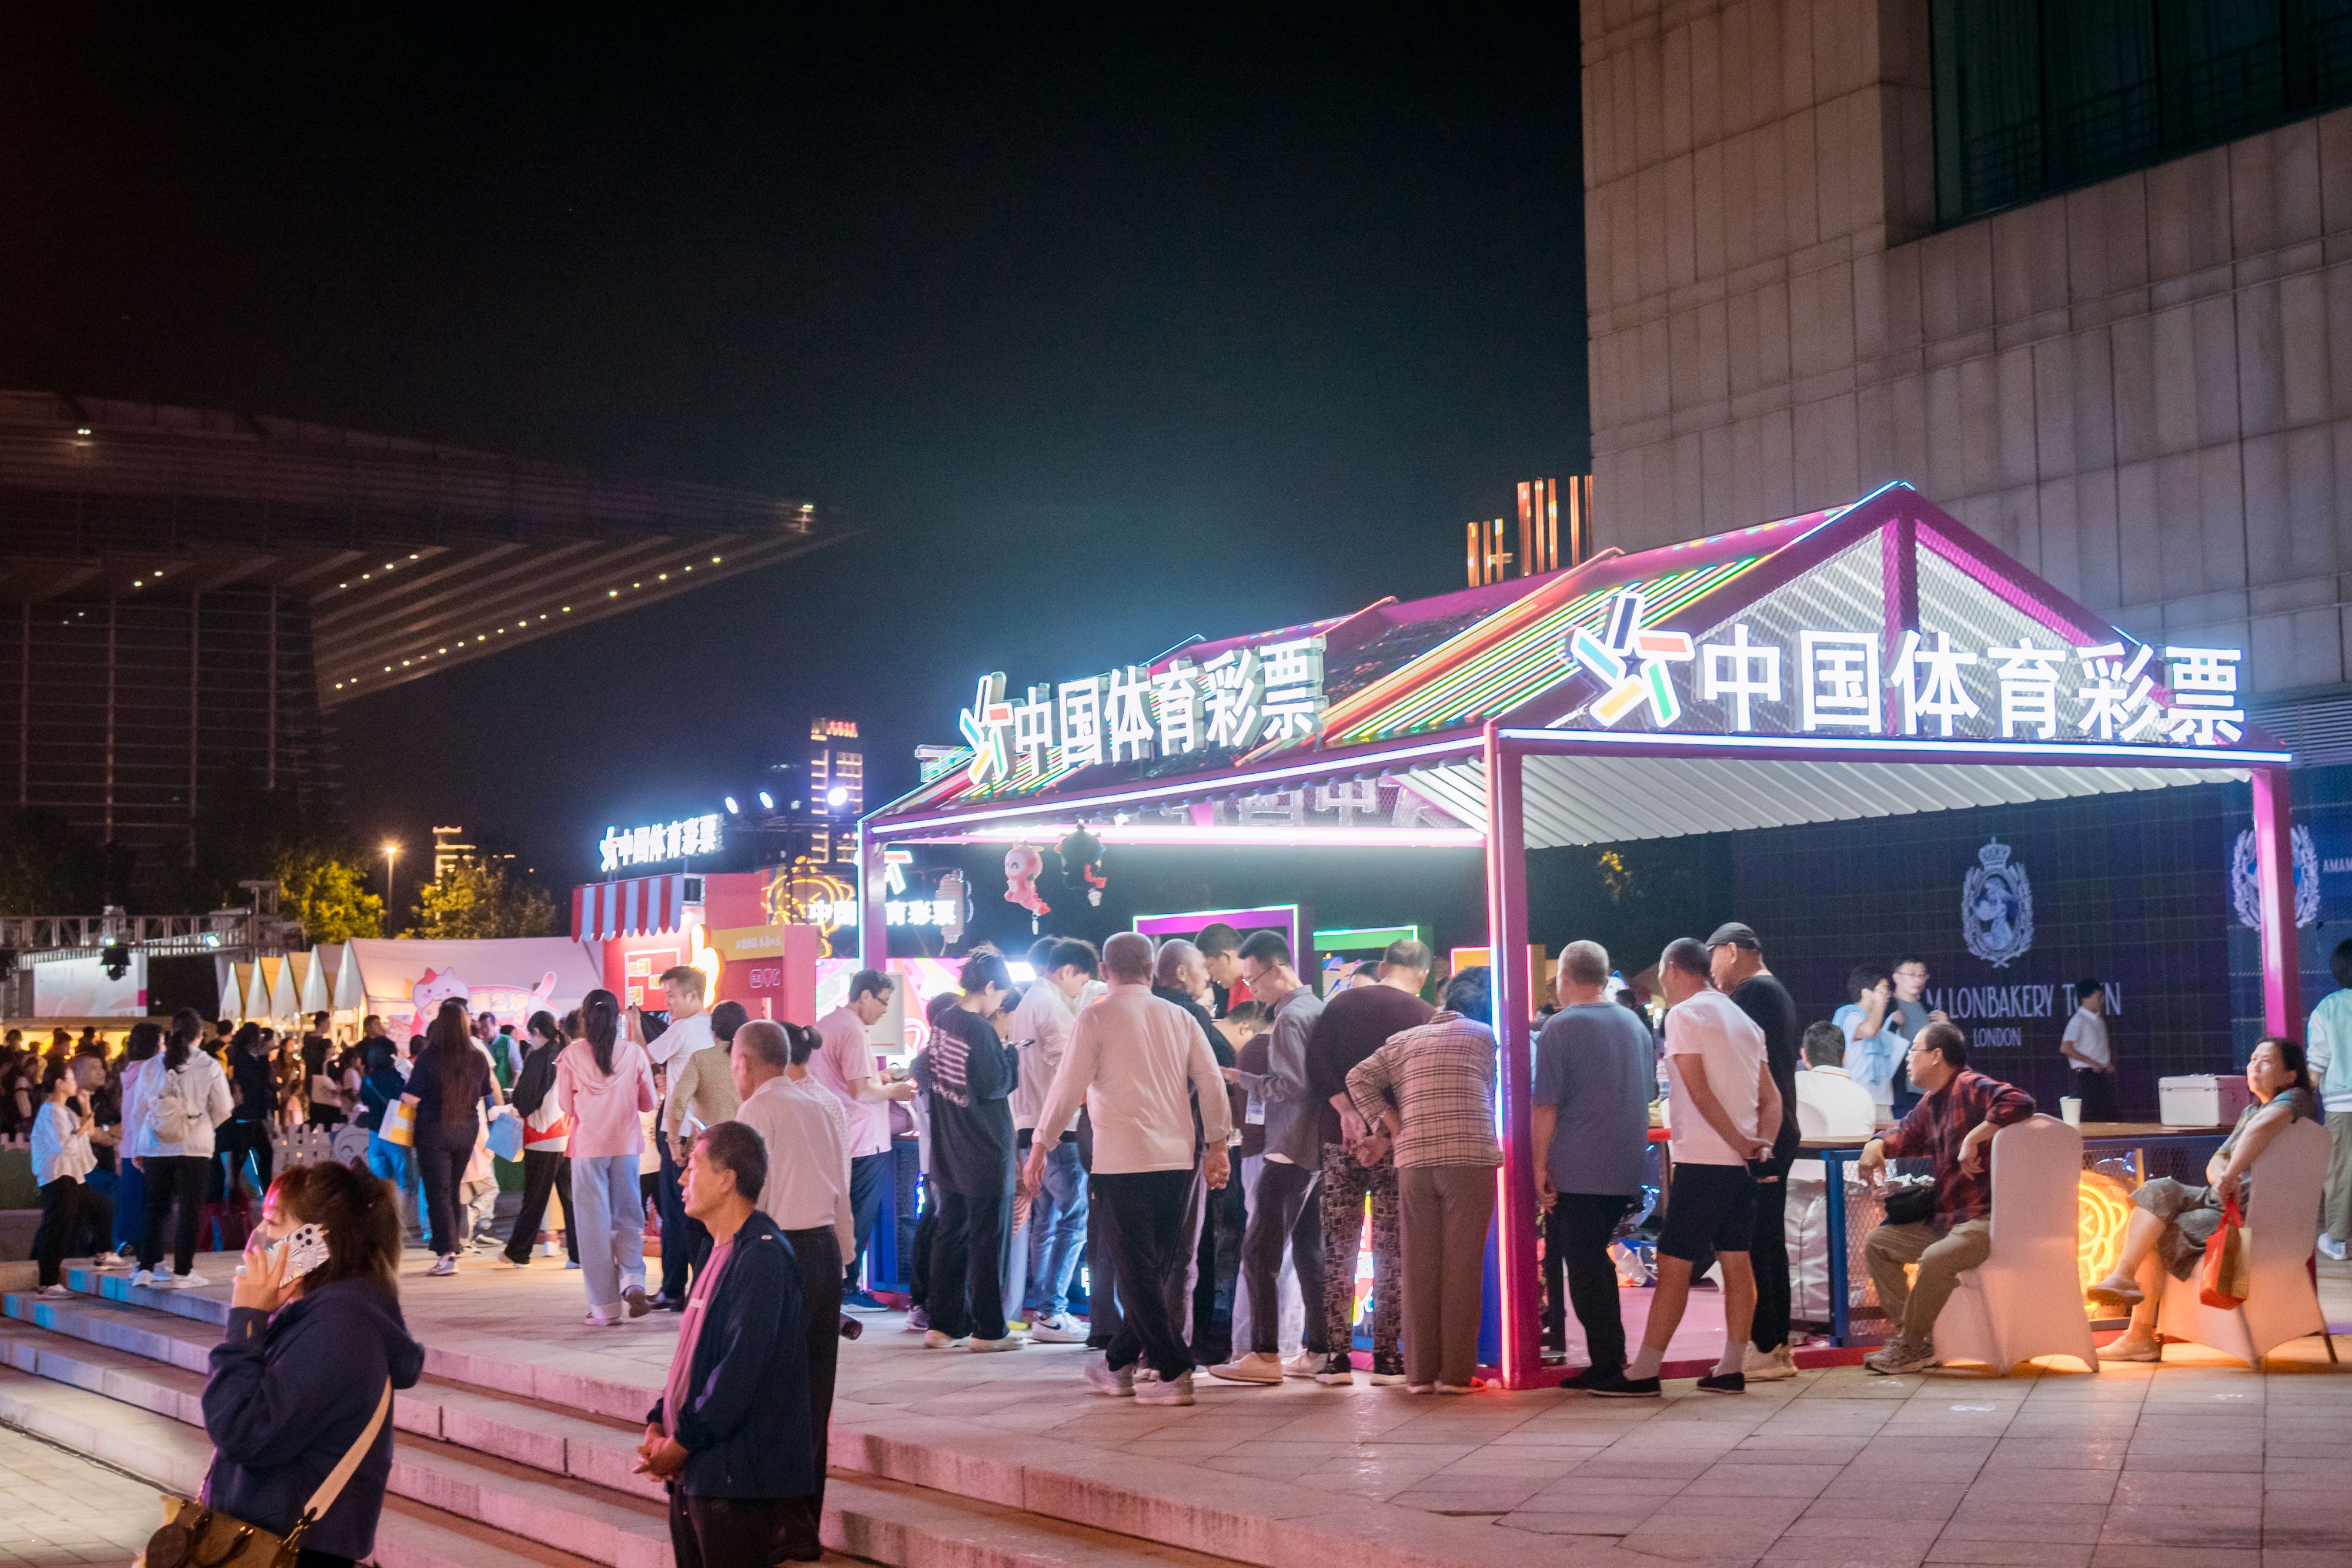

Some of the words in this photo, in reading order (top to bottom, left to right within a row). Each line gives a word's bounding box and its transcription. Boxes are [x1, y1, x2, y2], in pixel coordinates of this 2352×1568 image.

[1702, 622, 2245, 745] 中国体育彩票
[1014, 637, 1316, 783] 中国体育彩票
[618, 814, 719, 866] 中国体育彩票
[809, 900, 956, 926] 中国育彩票
[1948, 984, 2054, 1019] LONBAKERY
[2061, 982, 2122, 1017] TN
[1973, 1028, 2022, 1048] LONDON
